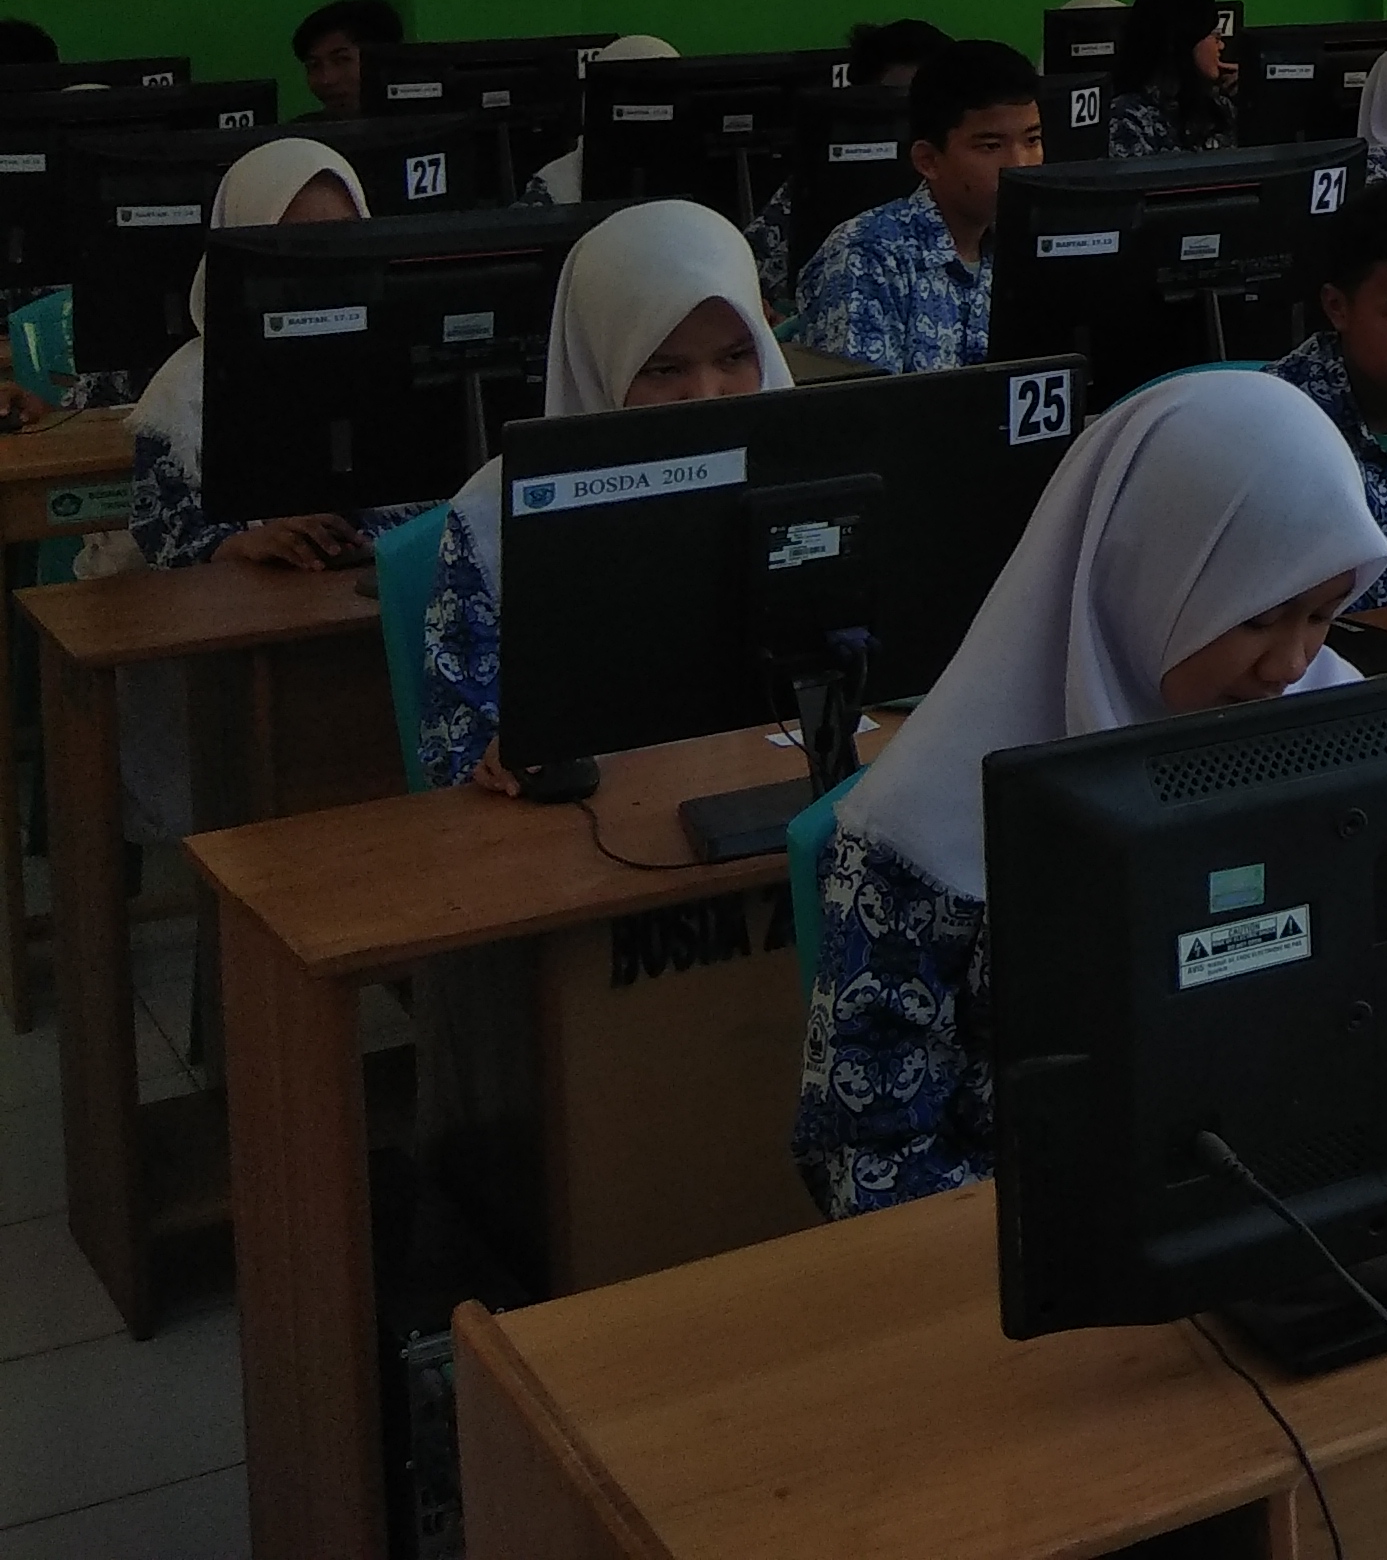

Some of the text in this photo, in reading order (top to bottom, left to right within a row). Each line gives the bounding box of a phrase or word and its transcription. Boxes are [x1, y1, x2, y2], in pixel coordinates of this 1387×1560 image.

[1075, 92, 1097, 124] 20
[413, 158, 441, 195] 27
[1315, 170, 1344, 211] 21
[1018, 375, 1065, 437] 25
[573, 463, 708, 498] BOSDA 2016
